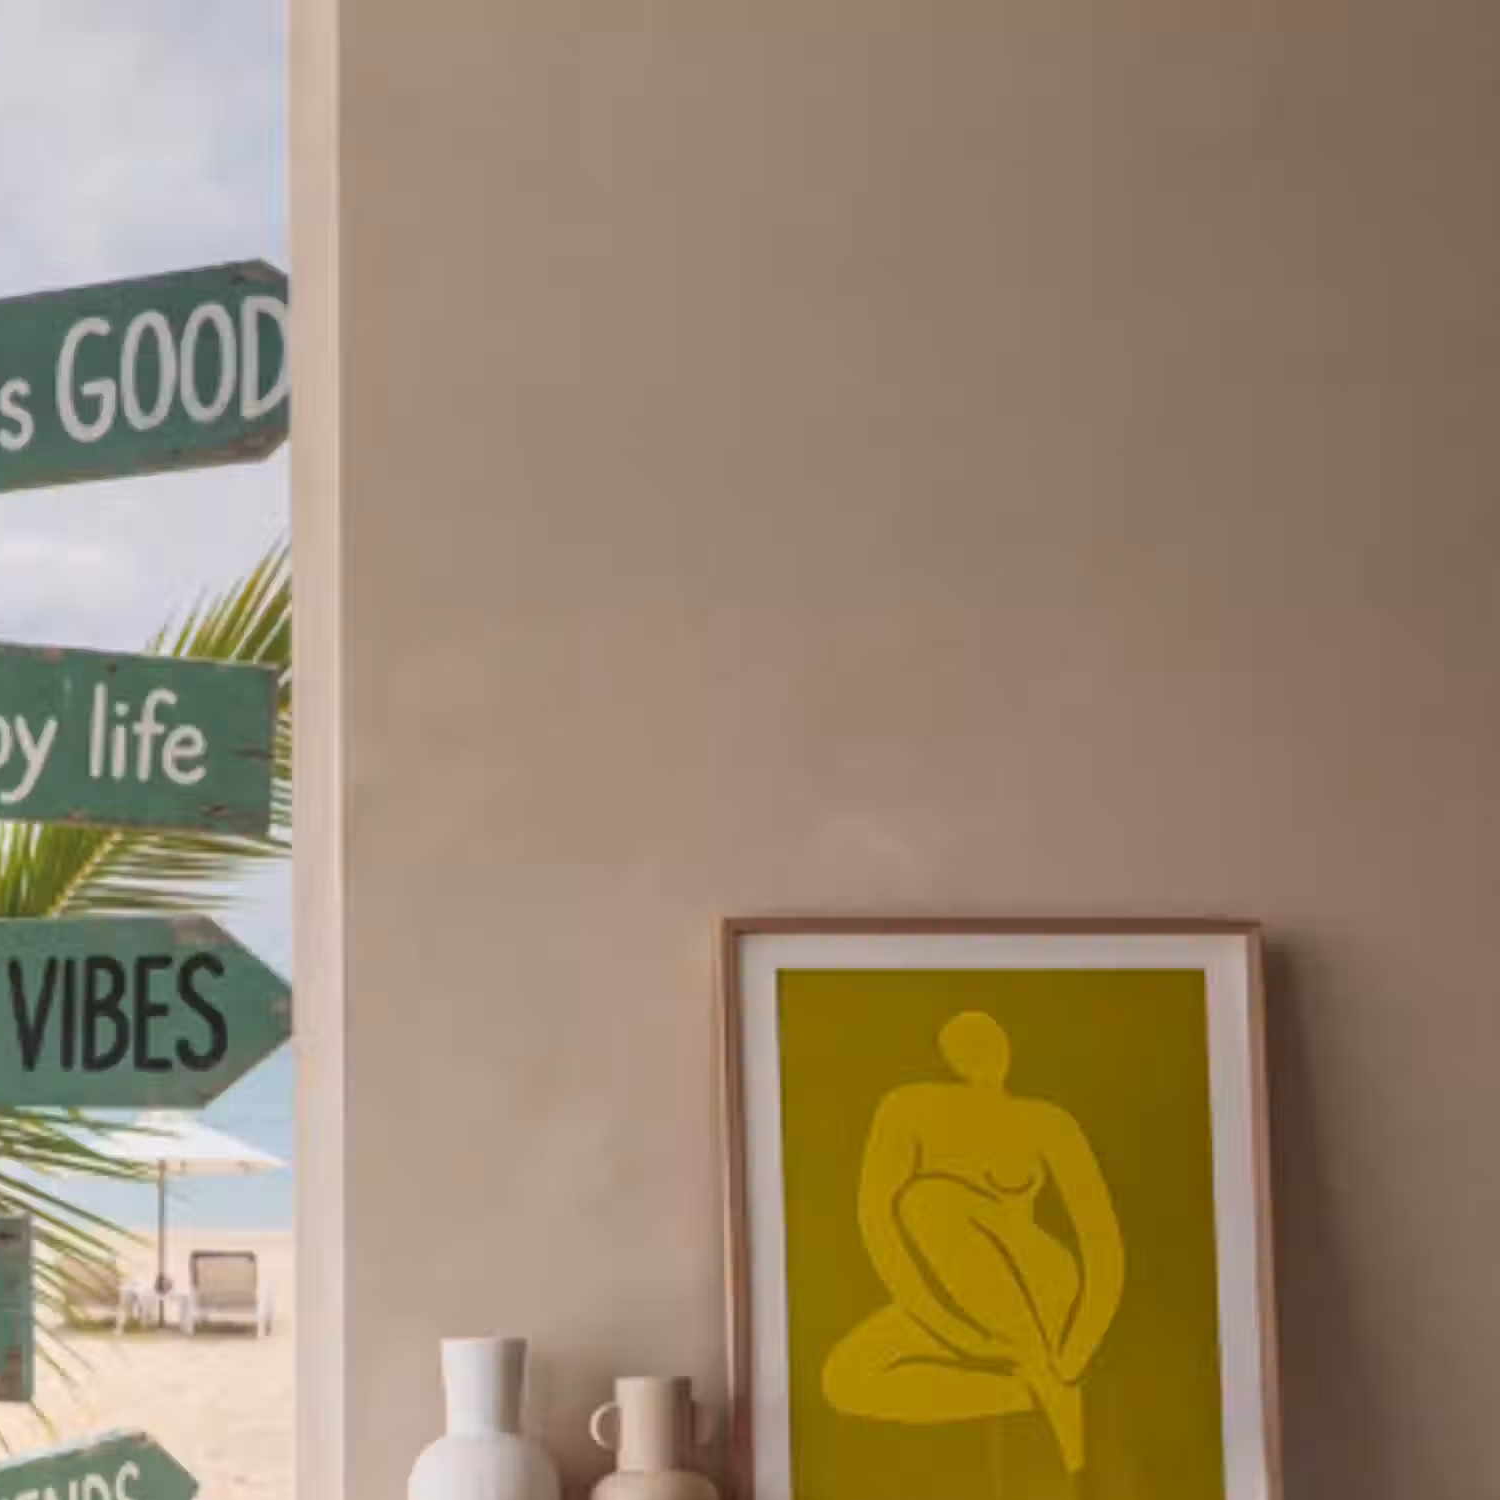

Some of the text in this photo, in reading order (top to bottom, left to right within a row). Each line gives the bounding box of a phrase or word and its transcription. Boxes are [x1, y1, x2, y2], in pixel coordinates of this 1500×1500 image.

[56, 294, 289, 442] GOOD
[90, 684, 207, 784] life
[8, 953, 229, 1072] VIBES
